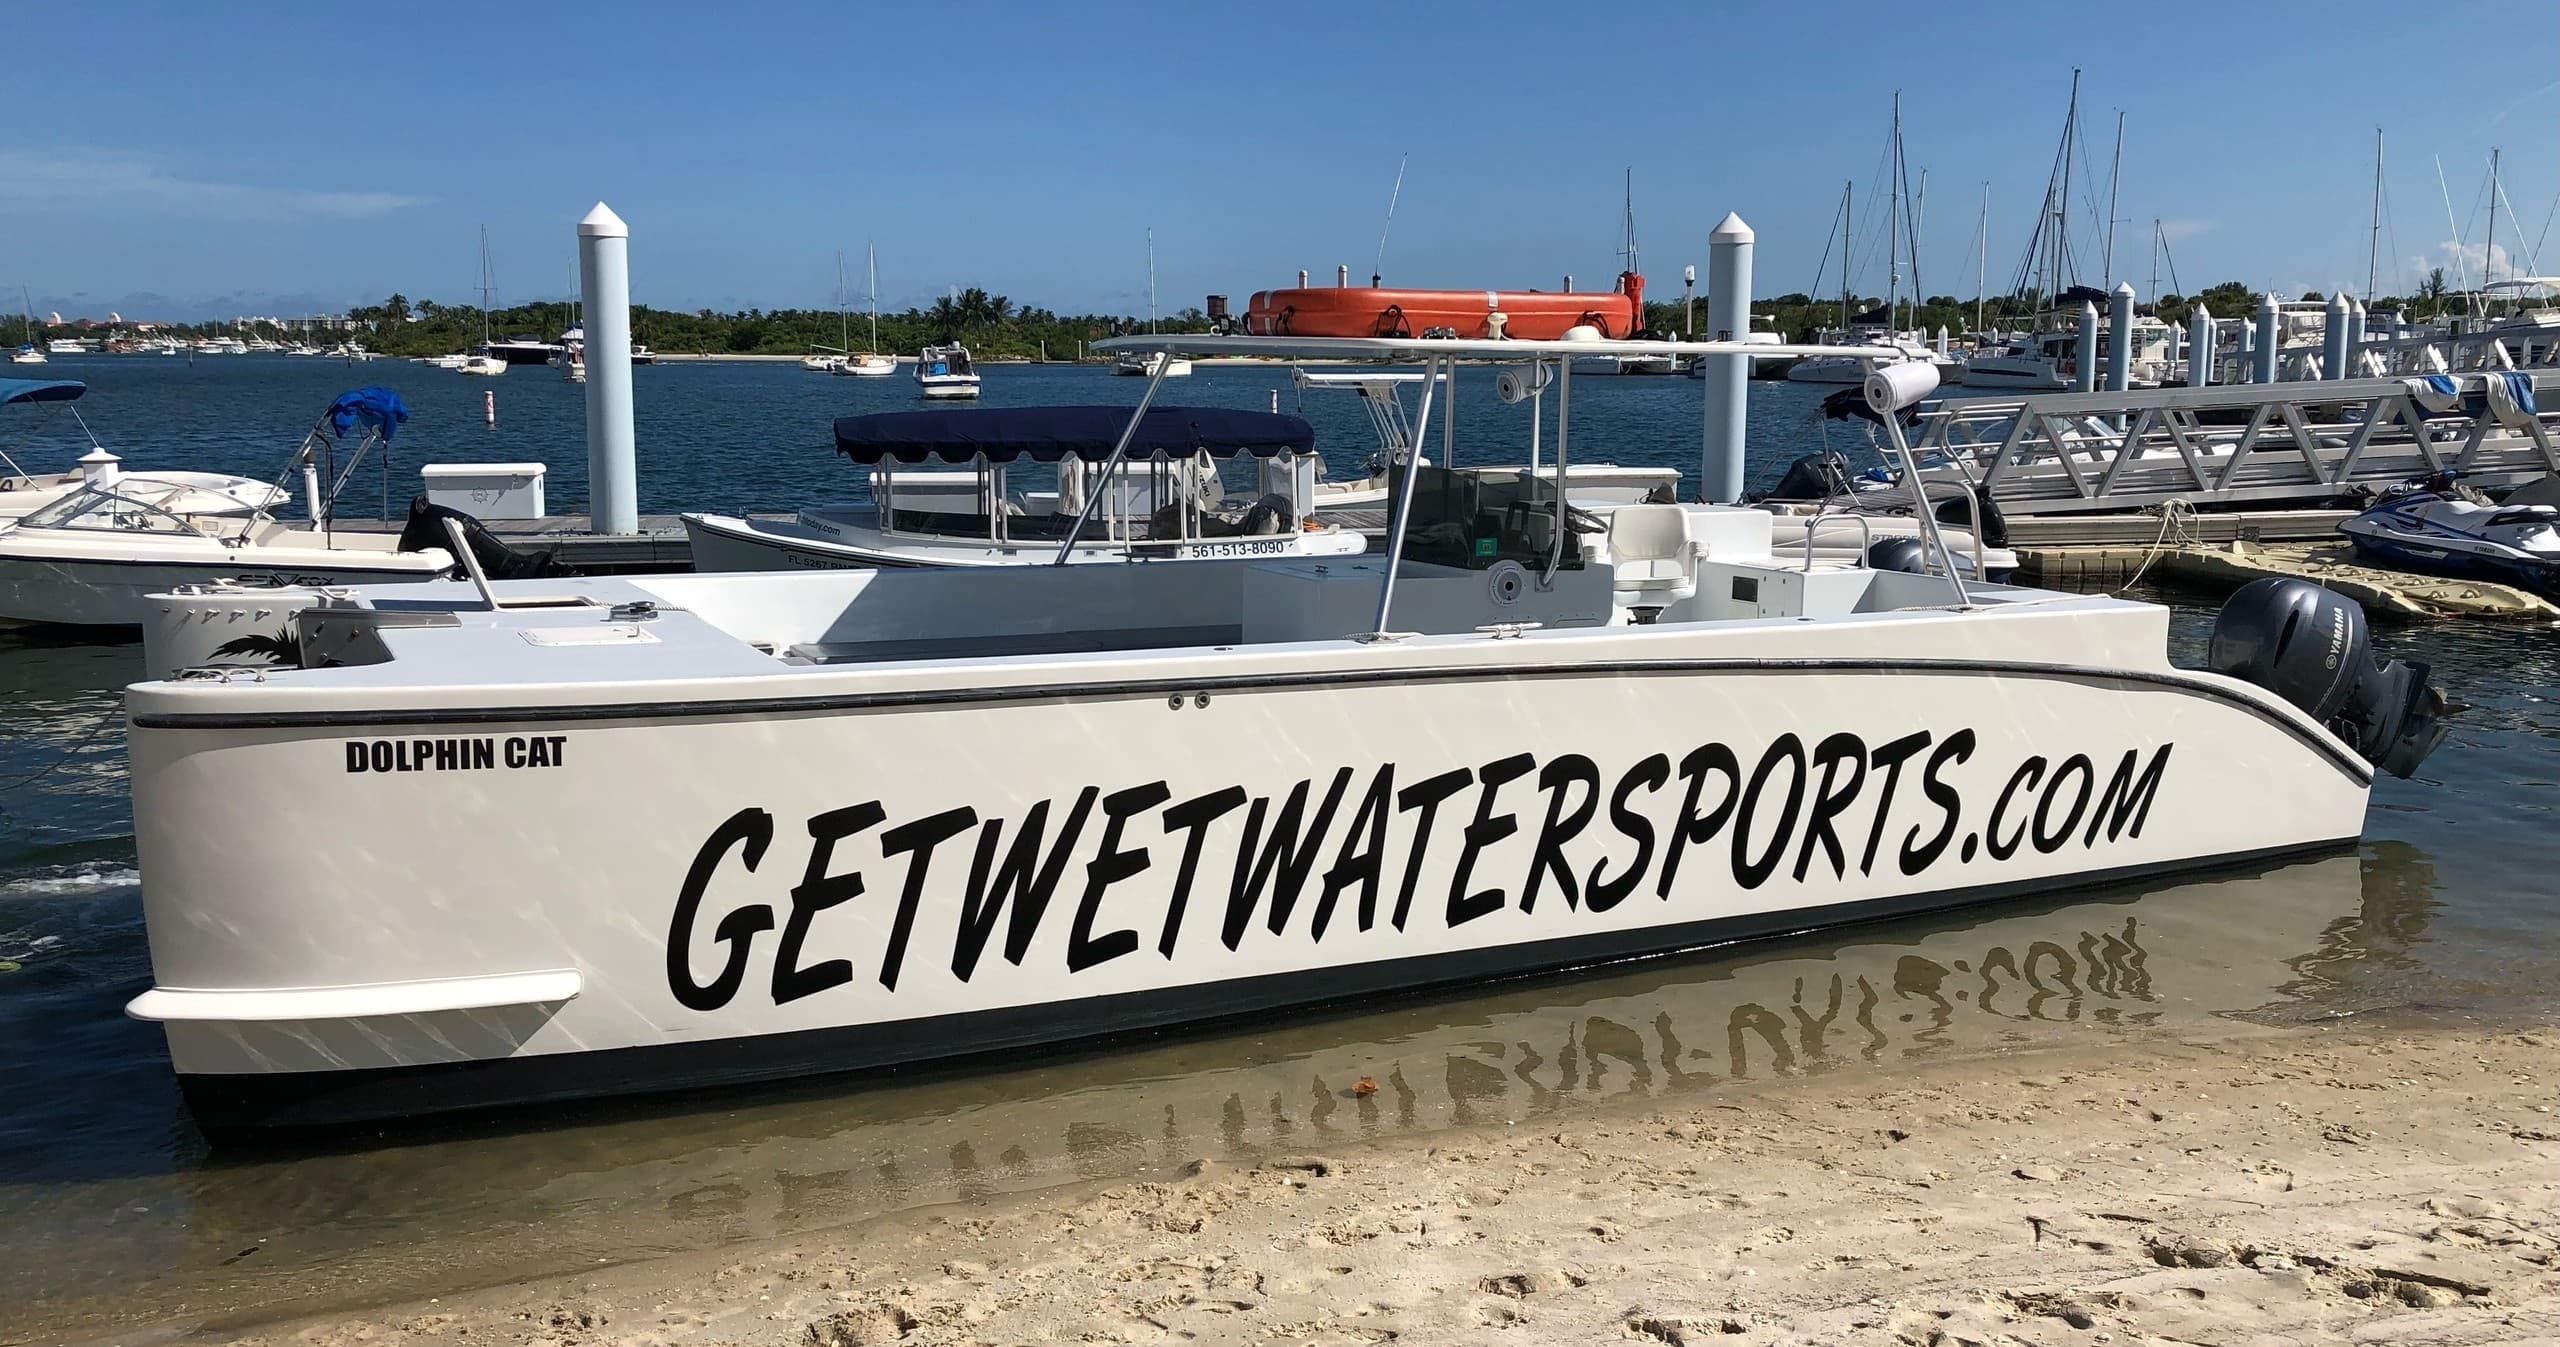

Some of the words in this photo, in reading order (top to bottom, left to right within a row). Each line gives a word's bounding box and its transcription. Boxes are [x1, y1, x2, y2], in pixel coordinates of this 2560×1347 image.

[1199, 470, 1211, 497] ZUKI
[1192, 541, 1284, 559] 561-513-8090
[2330, 606, 2345, 654] YAMAHA
[346, 740, 495, 773] DOLPHIN
[504, 736, 567, 769] CAT
[667, 729, 2173, 1011] GETWETWATERSPORTS.COM
